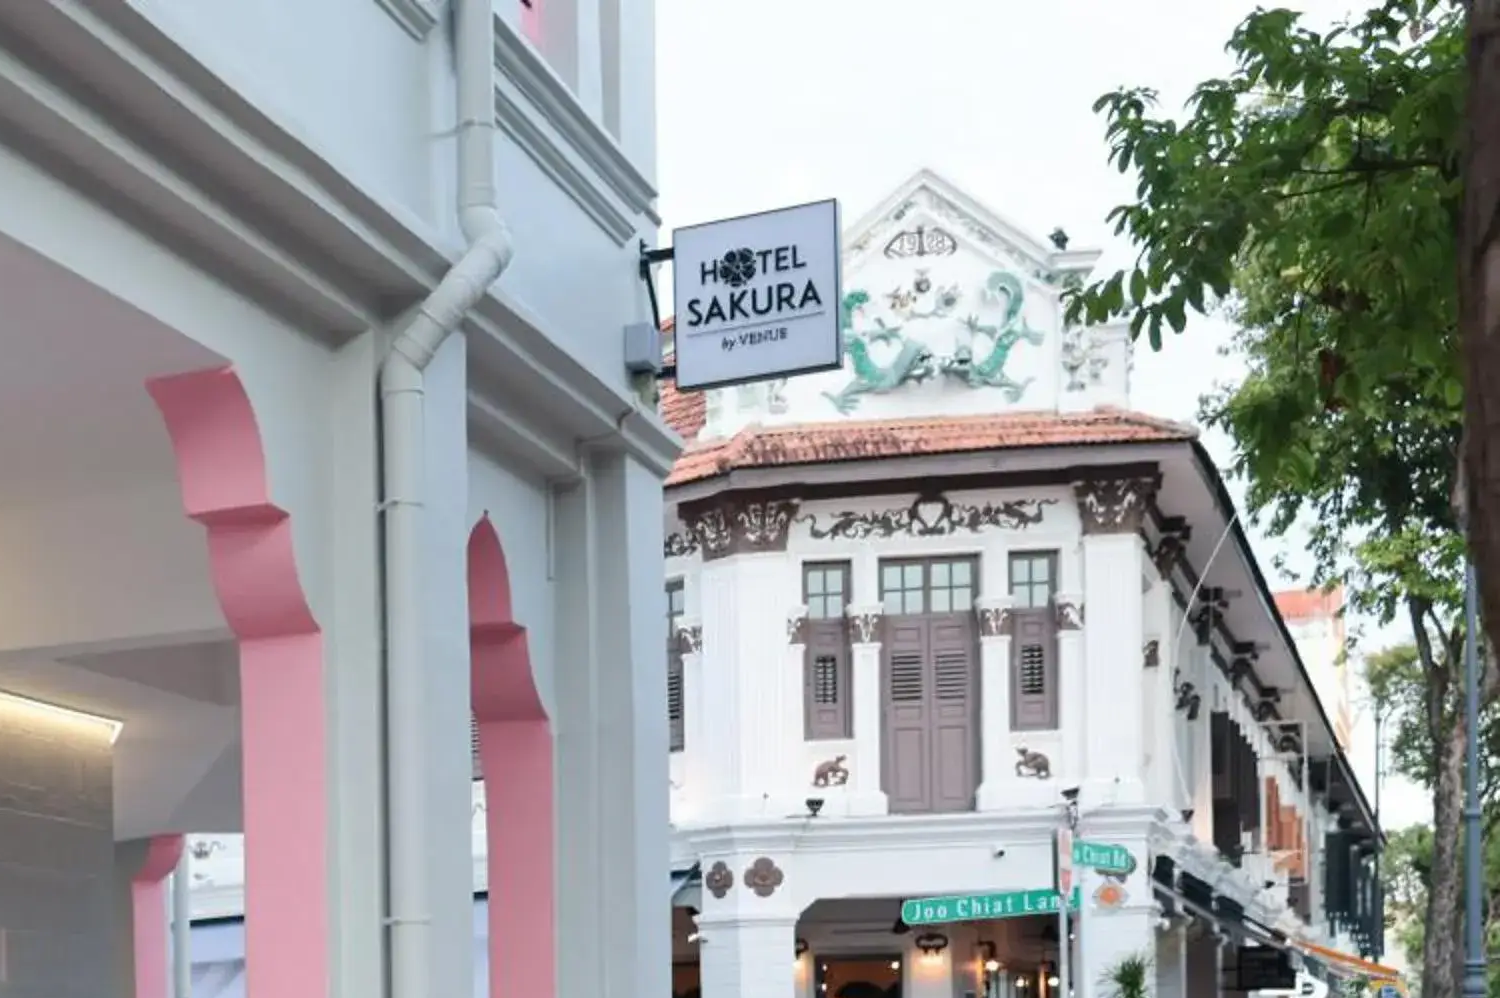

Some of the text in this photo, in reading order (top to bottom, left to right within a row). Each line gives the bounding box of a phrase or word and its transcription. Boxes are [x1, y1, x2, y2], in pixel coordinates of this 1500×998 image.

[687, 278, 822, 327] SAKURA
[721, 336, 736, 351] by
[912, 903, 948, 921] Joo
[956, 897, 1014, 917] Chiat
